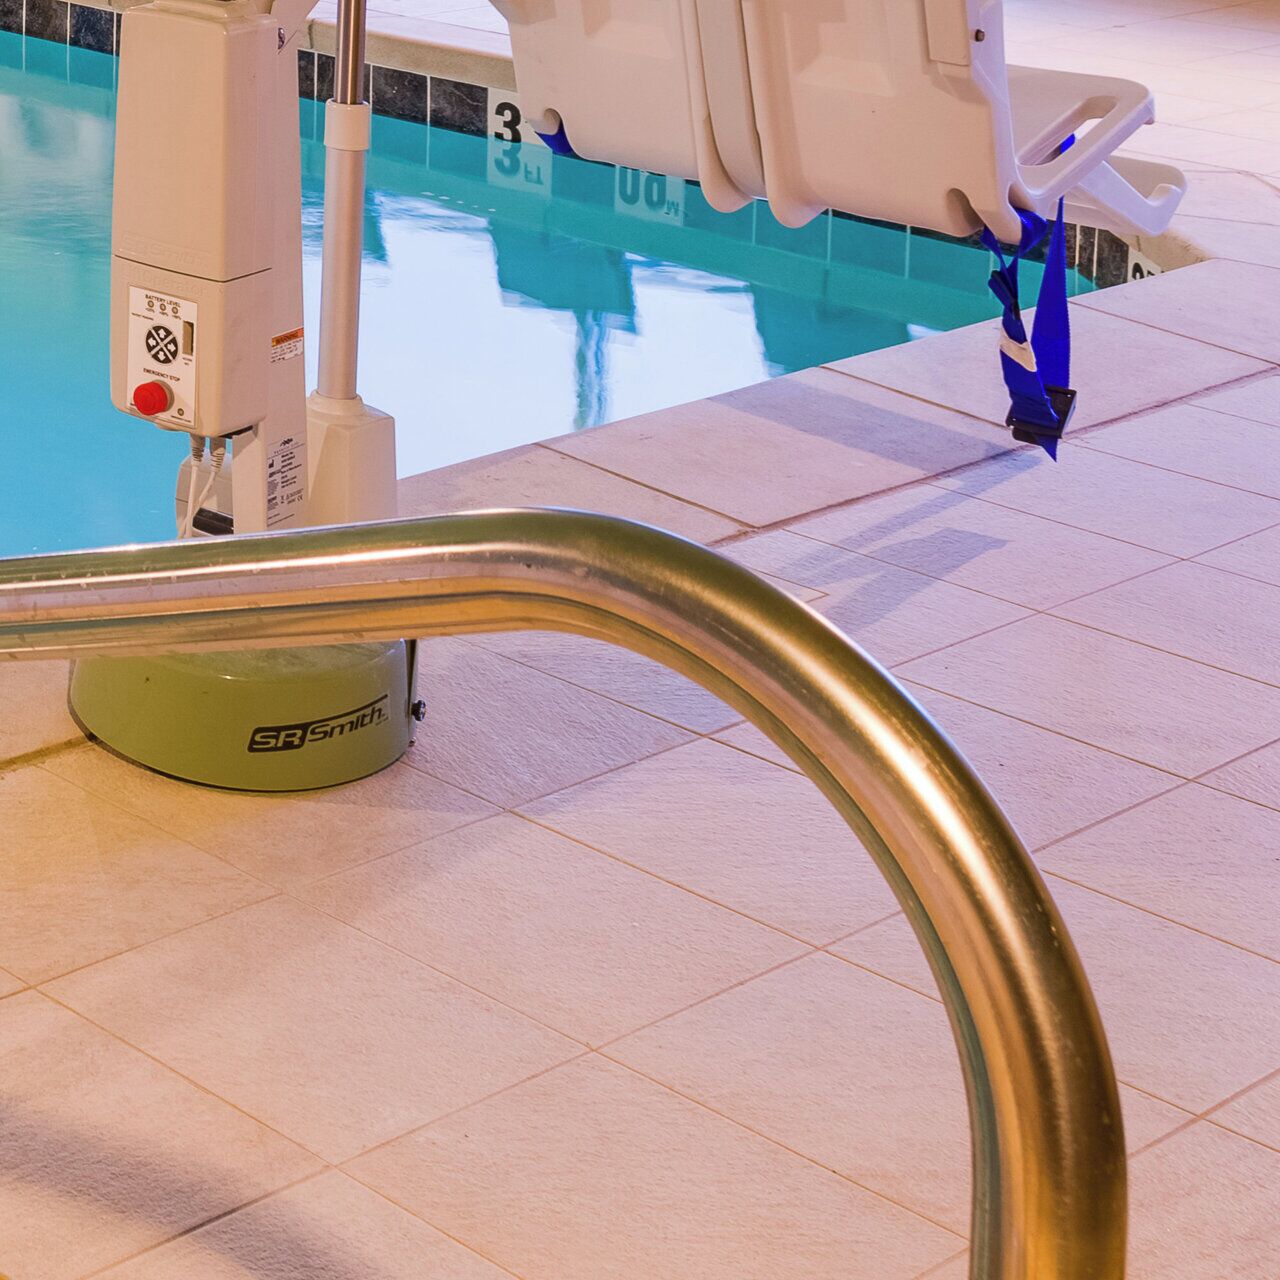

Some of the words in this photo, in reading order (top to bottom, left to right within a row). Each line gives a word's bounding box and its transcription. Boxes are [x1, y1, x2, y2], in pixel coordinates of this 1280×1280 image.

[494, 101, 522, 144] 3
[145, 293, 166, 304] BATTERY
[166, 299, 181, 308] LEVEL
[307, 705, 385, 743] Smith
